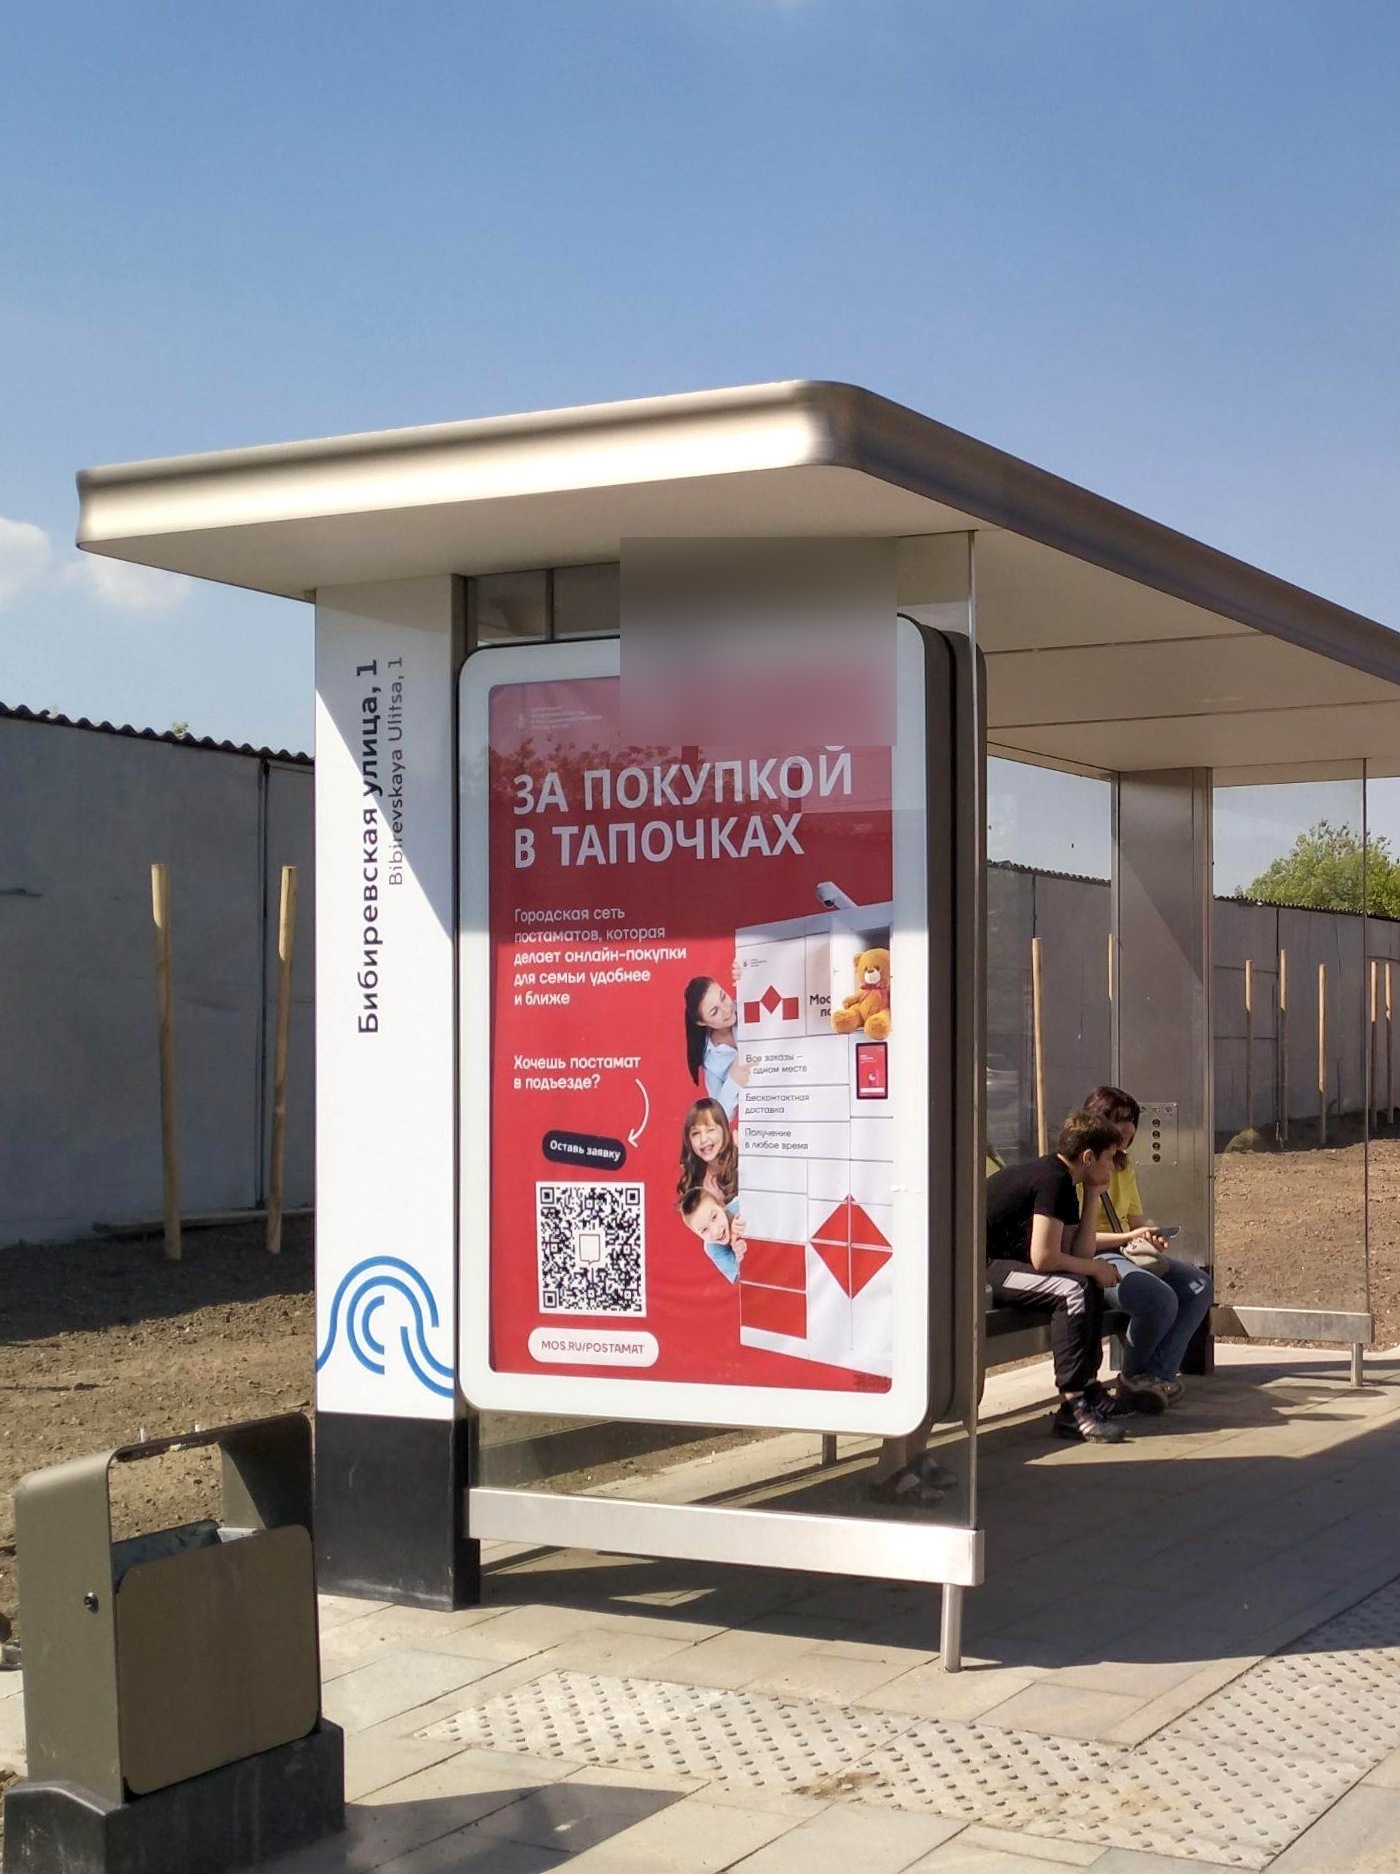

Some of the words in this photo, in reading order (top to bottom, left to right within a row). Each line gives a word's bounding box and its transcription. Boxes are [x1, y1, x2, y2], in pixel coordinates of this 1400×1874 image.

[357, 658, 377, 677] 1
[387, 656, 402, 668] 1
[387, 675, 404, 741] Ulitsa,
[361, 683, 383, 798] улица,
[513, 771, 569, 815] ЗА
[584, 746, 852, 811] ПОКУПКОЙ
[388, 748, 404, 886] Bibirevskaya
[515, 828, 535, 869] В
[552, 812, 805, 866] ТАПОЧКАХ
[357, 808, 383, 1034] Бибиревская
[514, 908, 590, 924] Городская
[593, 907, 626, 920] сеть
[514, 929, 602, 943] постаматов,
[606, 927, 666, 942] которая
[513, 950, 561, 965] делает
[564, 947, 687, 964] онлайн-покупки
[513, 972, 535, 987] для
[539, 971, 585, 984] семьи
[589, 968, 651, 986] удобнее
[514, 994, 522, 1006] и
[525, 991, 570, 1005] ближе
[513, 1055, 566, 1070] Хочешь
[569, 1057, 641, 1069] постамат
[745, 1054, 763, 1063] Все
[764, 1054, 795, 1063] заказы
[513, 1078, 521, 1089] в
[525, 1073, 601, 1091] подъезде?
[745, 1093, 811, 1102] Бесконтактная
[744, 1128, 792, 1139] Получение
[549, 1140, 585, 1155] Оставь
[585, 1146, 622, 1162] заявку
[751, 1141, 780, 1149] любое
[781, 1142, 809, 1150] время
[541, 1340, 645, 1355] MOS.RU/POSTAMAT
